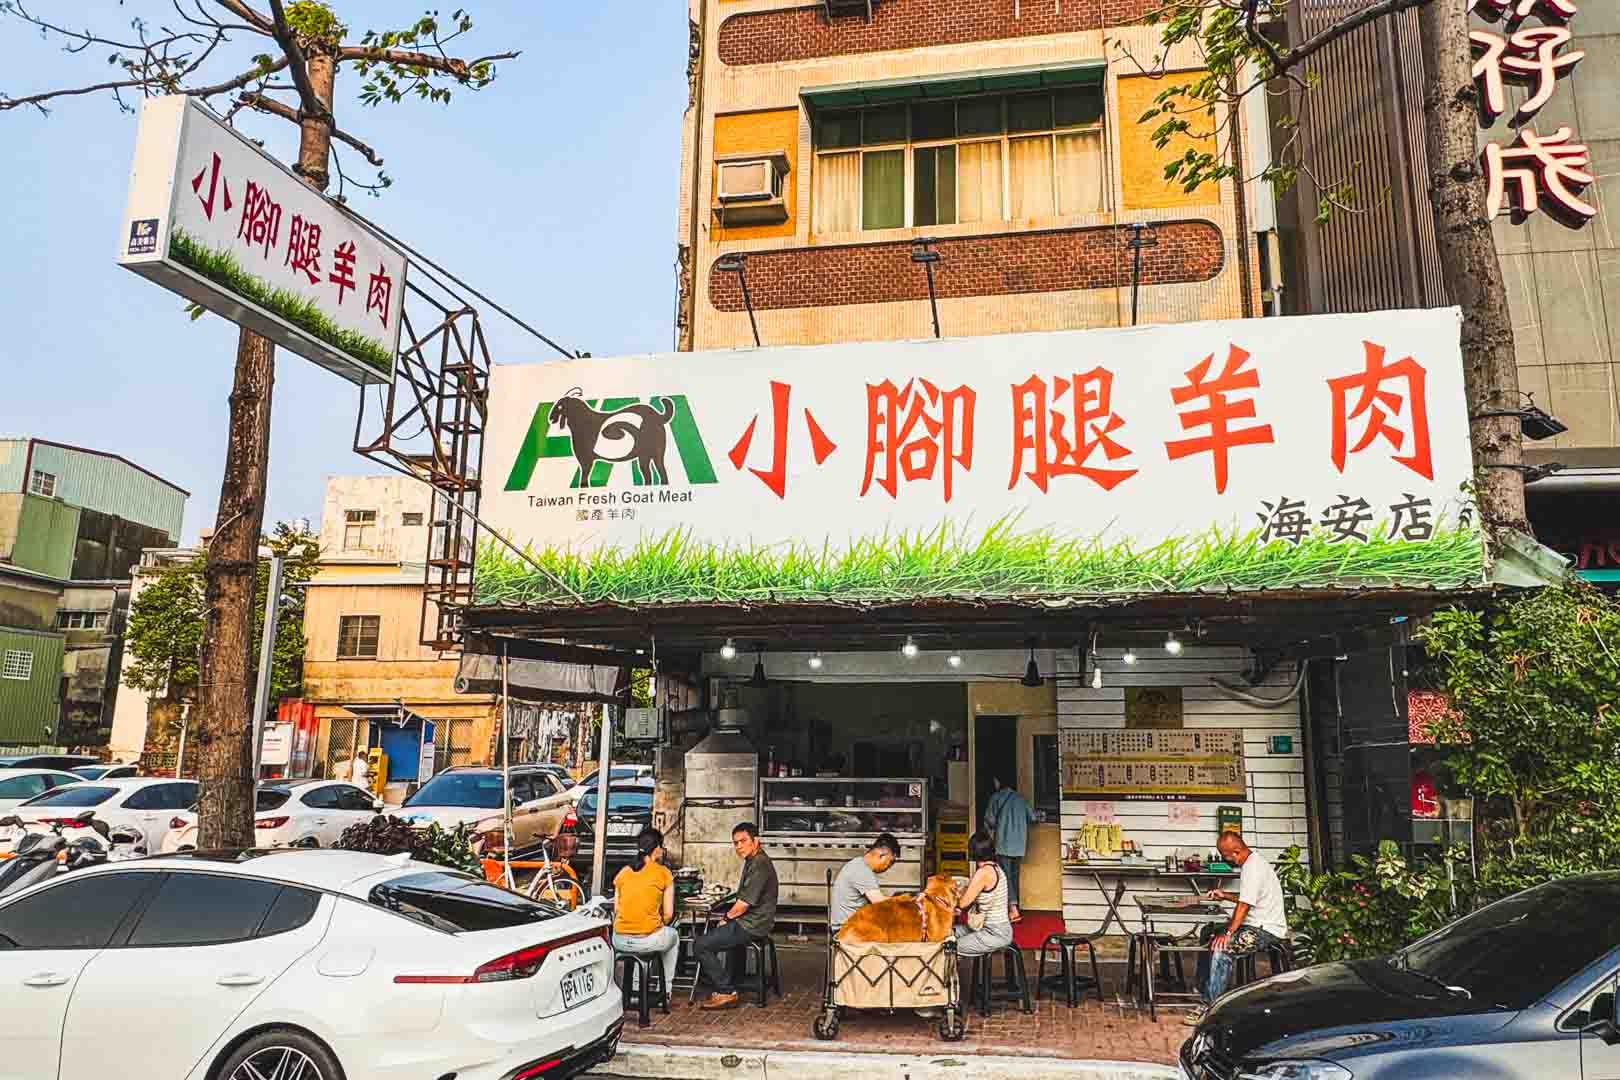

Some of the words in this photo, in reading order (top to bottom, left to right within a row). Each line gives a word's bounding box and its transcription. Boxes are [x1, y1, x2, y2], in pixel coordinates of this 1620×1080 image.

[192, 151, 392, 329] 小腳腿羊肉
[727, 341, 1434, 504] 小腳腿羊肉
[528, 494, 574, 508] Taiwan
[578, 492, 617, 506] Fresh
[621, 490, 656, 505] Goat
[659, 489, 693, 503] Meat
[1256, 493, 1434, 545] 海安店
